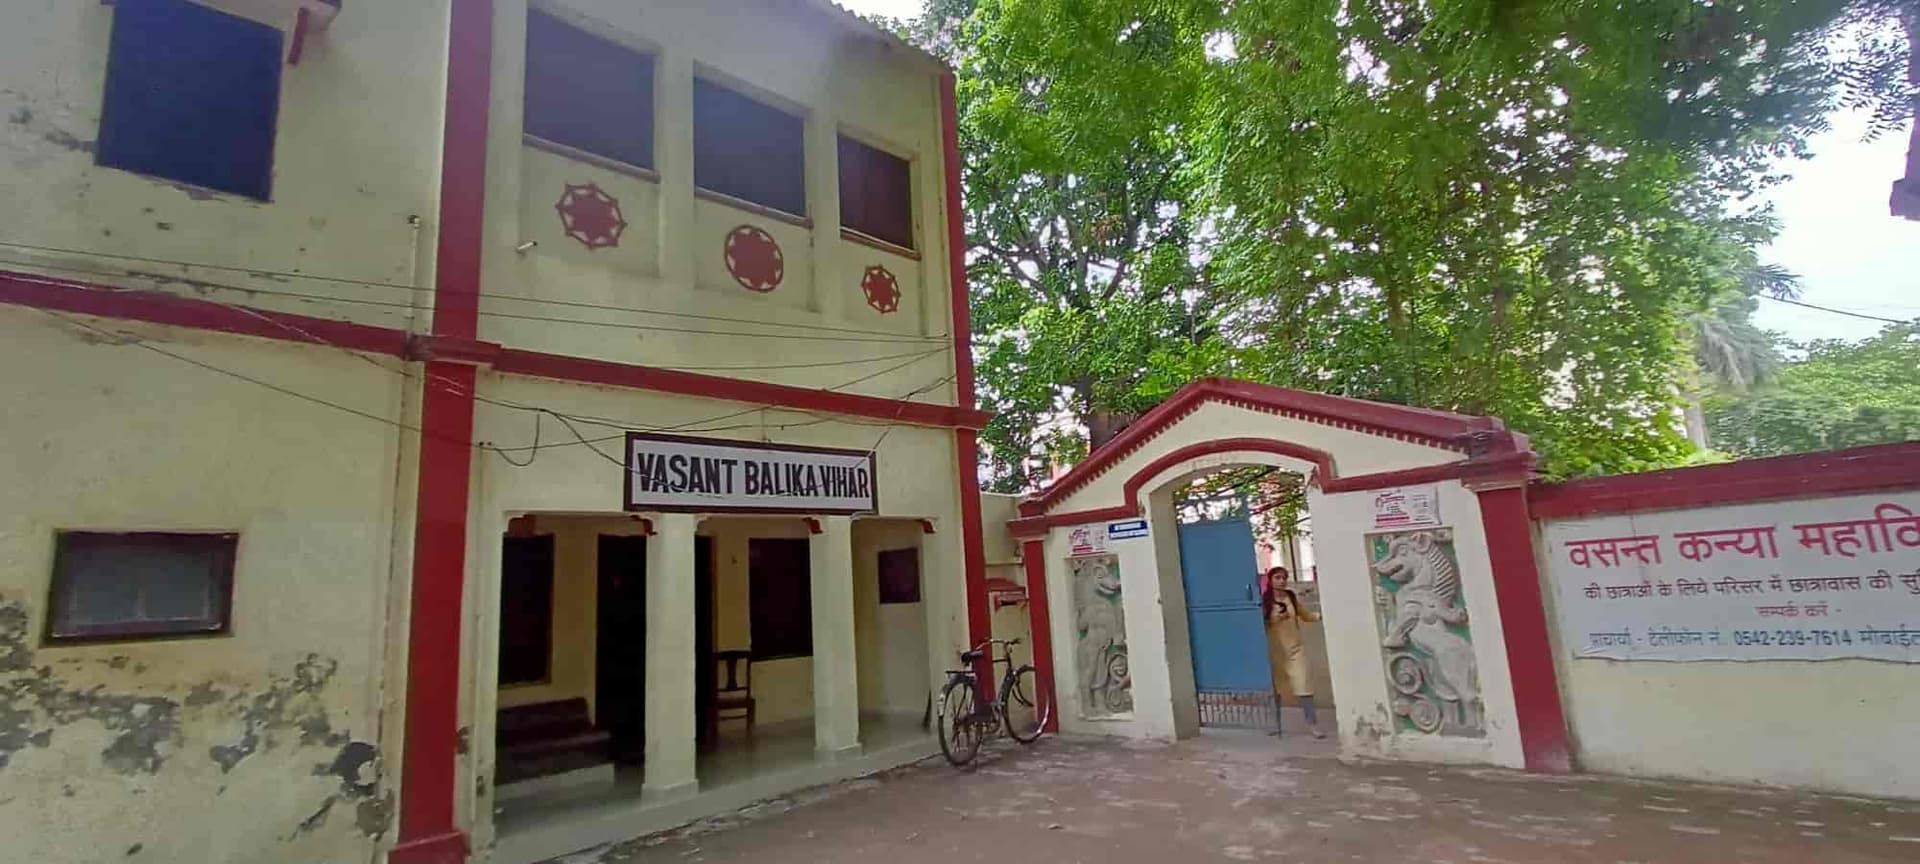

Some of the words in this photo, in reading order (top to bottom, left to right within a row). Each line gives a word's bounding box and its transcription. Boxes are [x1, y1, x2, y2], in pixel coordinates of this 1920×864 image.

[637, 452, 738, 494] VASANT
[744, 460, 817, 497] BALIKA
[819, 465, 871, 499] VIHAR
[1565, 535, 1661, 568] वसन्त
[1674, 526, 1778, 562] कन्या
[1583, 582, 1601, 600] की
[1605, 580, 1653, 600] छात्राओं
[1656, 580, 1673, 597] के
[1676, 578, 1708, 597] लिये
[1713, 575, 1764, 595] परिसर
[1768, 574, 1784, 592] में
[1788, 576, 1862, 593] छात्रावास
[1867, 569, 1894, 590] की
[1898, 569, 1920, 595] सु
[1755, 601, 1799, 618] सम्पर्क
[1733, 628, 1853, 647] 0542-239-7614
